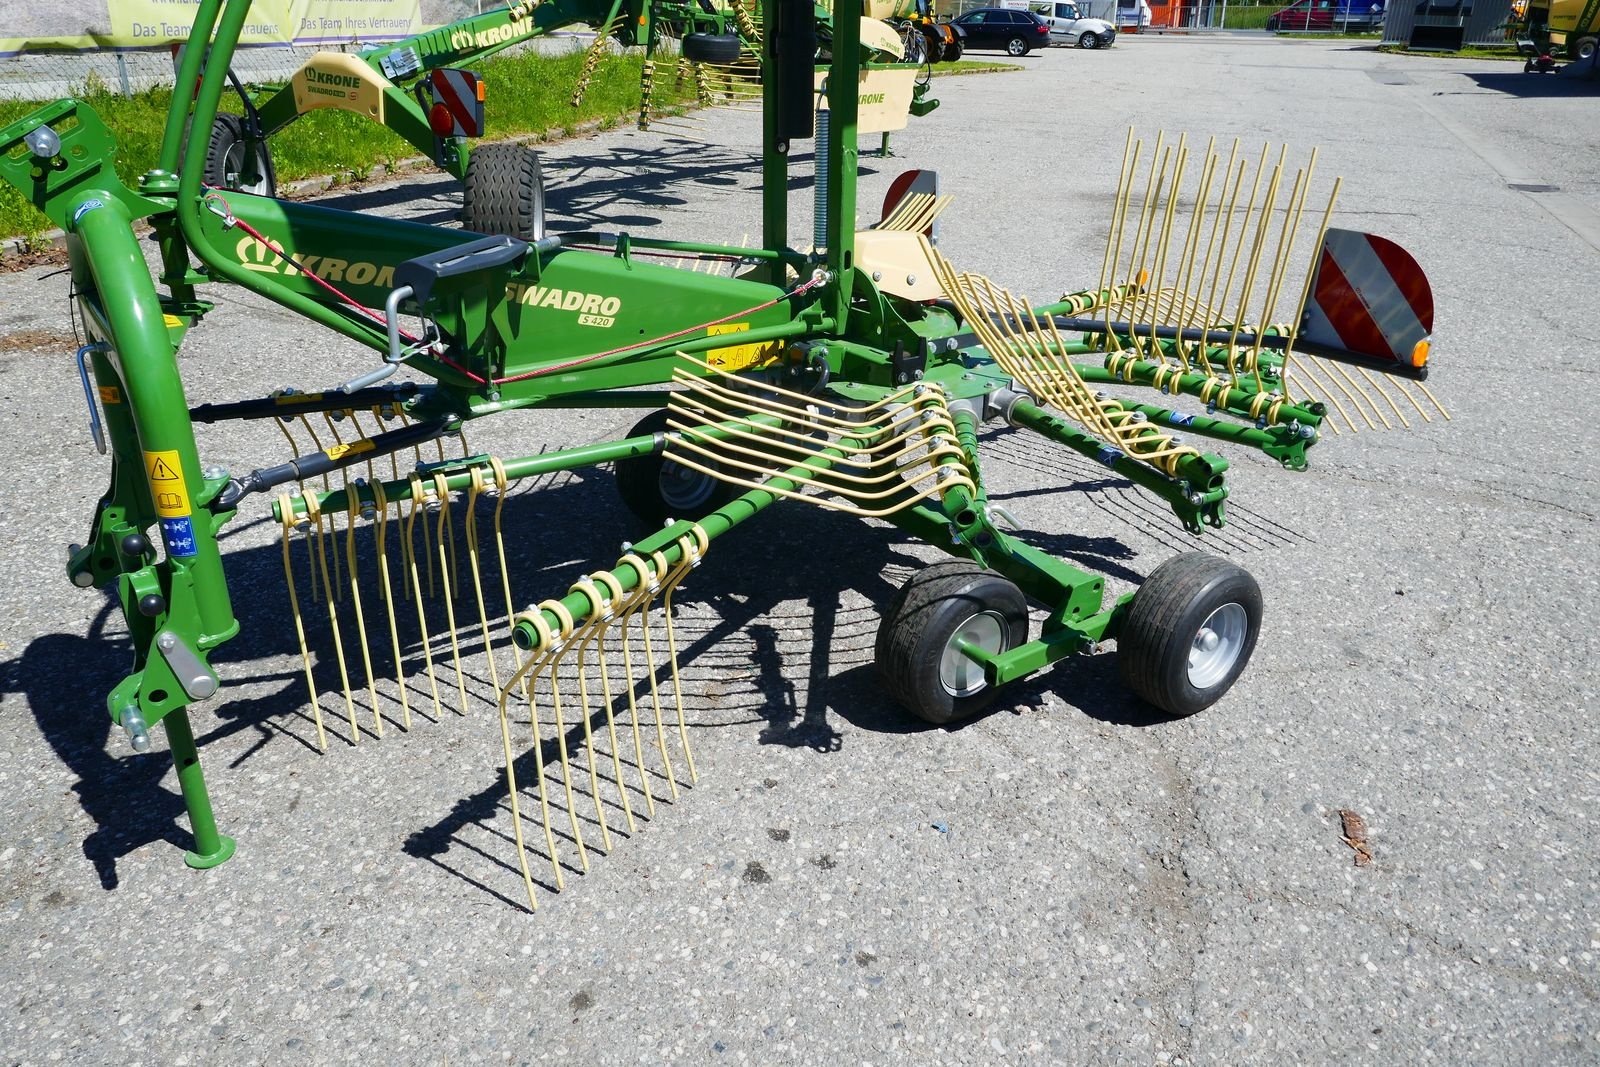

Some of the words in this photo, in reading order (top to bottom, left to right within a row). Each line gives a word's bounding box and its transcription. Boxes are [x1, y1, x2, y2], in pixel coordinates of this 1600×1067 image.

[132, 22, 157, 38] Das
[160, 22, 191, 37] Team
[300, 17, 317, 30] Das
[318, 17, 342, 30] Team
[345, 16, 367, 29] Ihres
[368, 16, 412, 29] Vertrauens
[475, 16, 535, 48] KRONE
[317, 72, 361, 89] KRONE
[505, 282, 621, 316] SWADRO
[582, 316, 590, 324] S
[591, 317, 610, 326] 420
